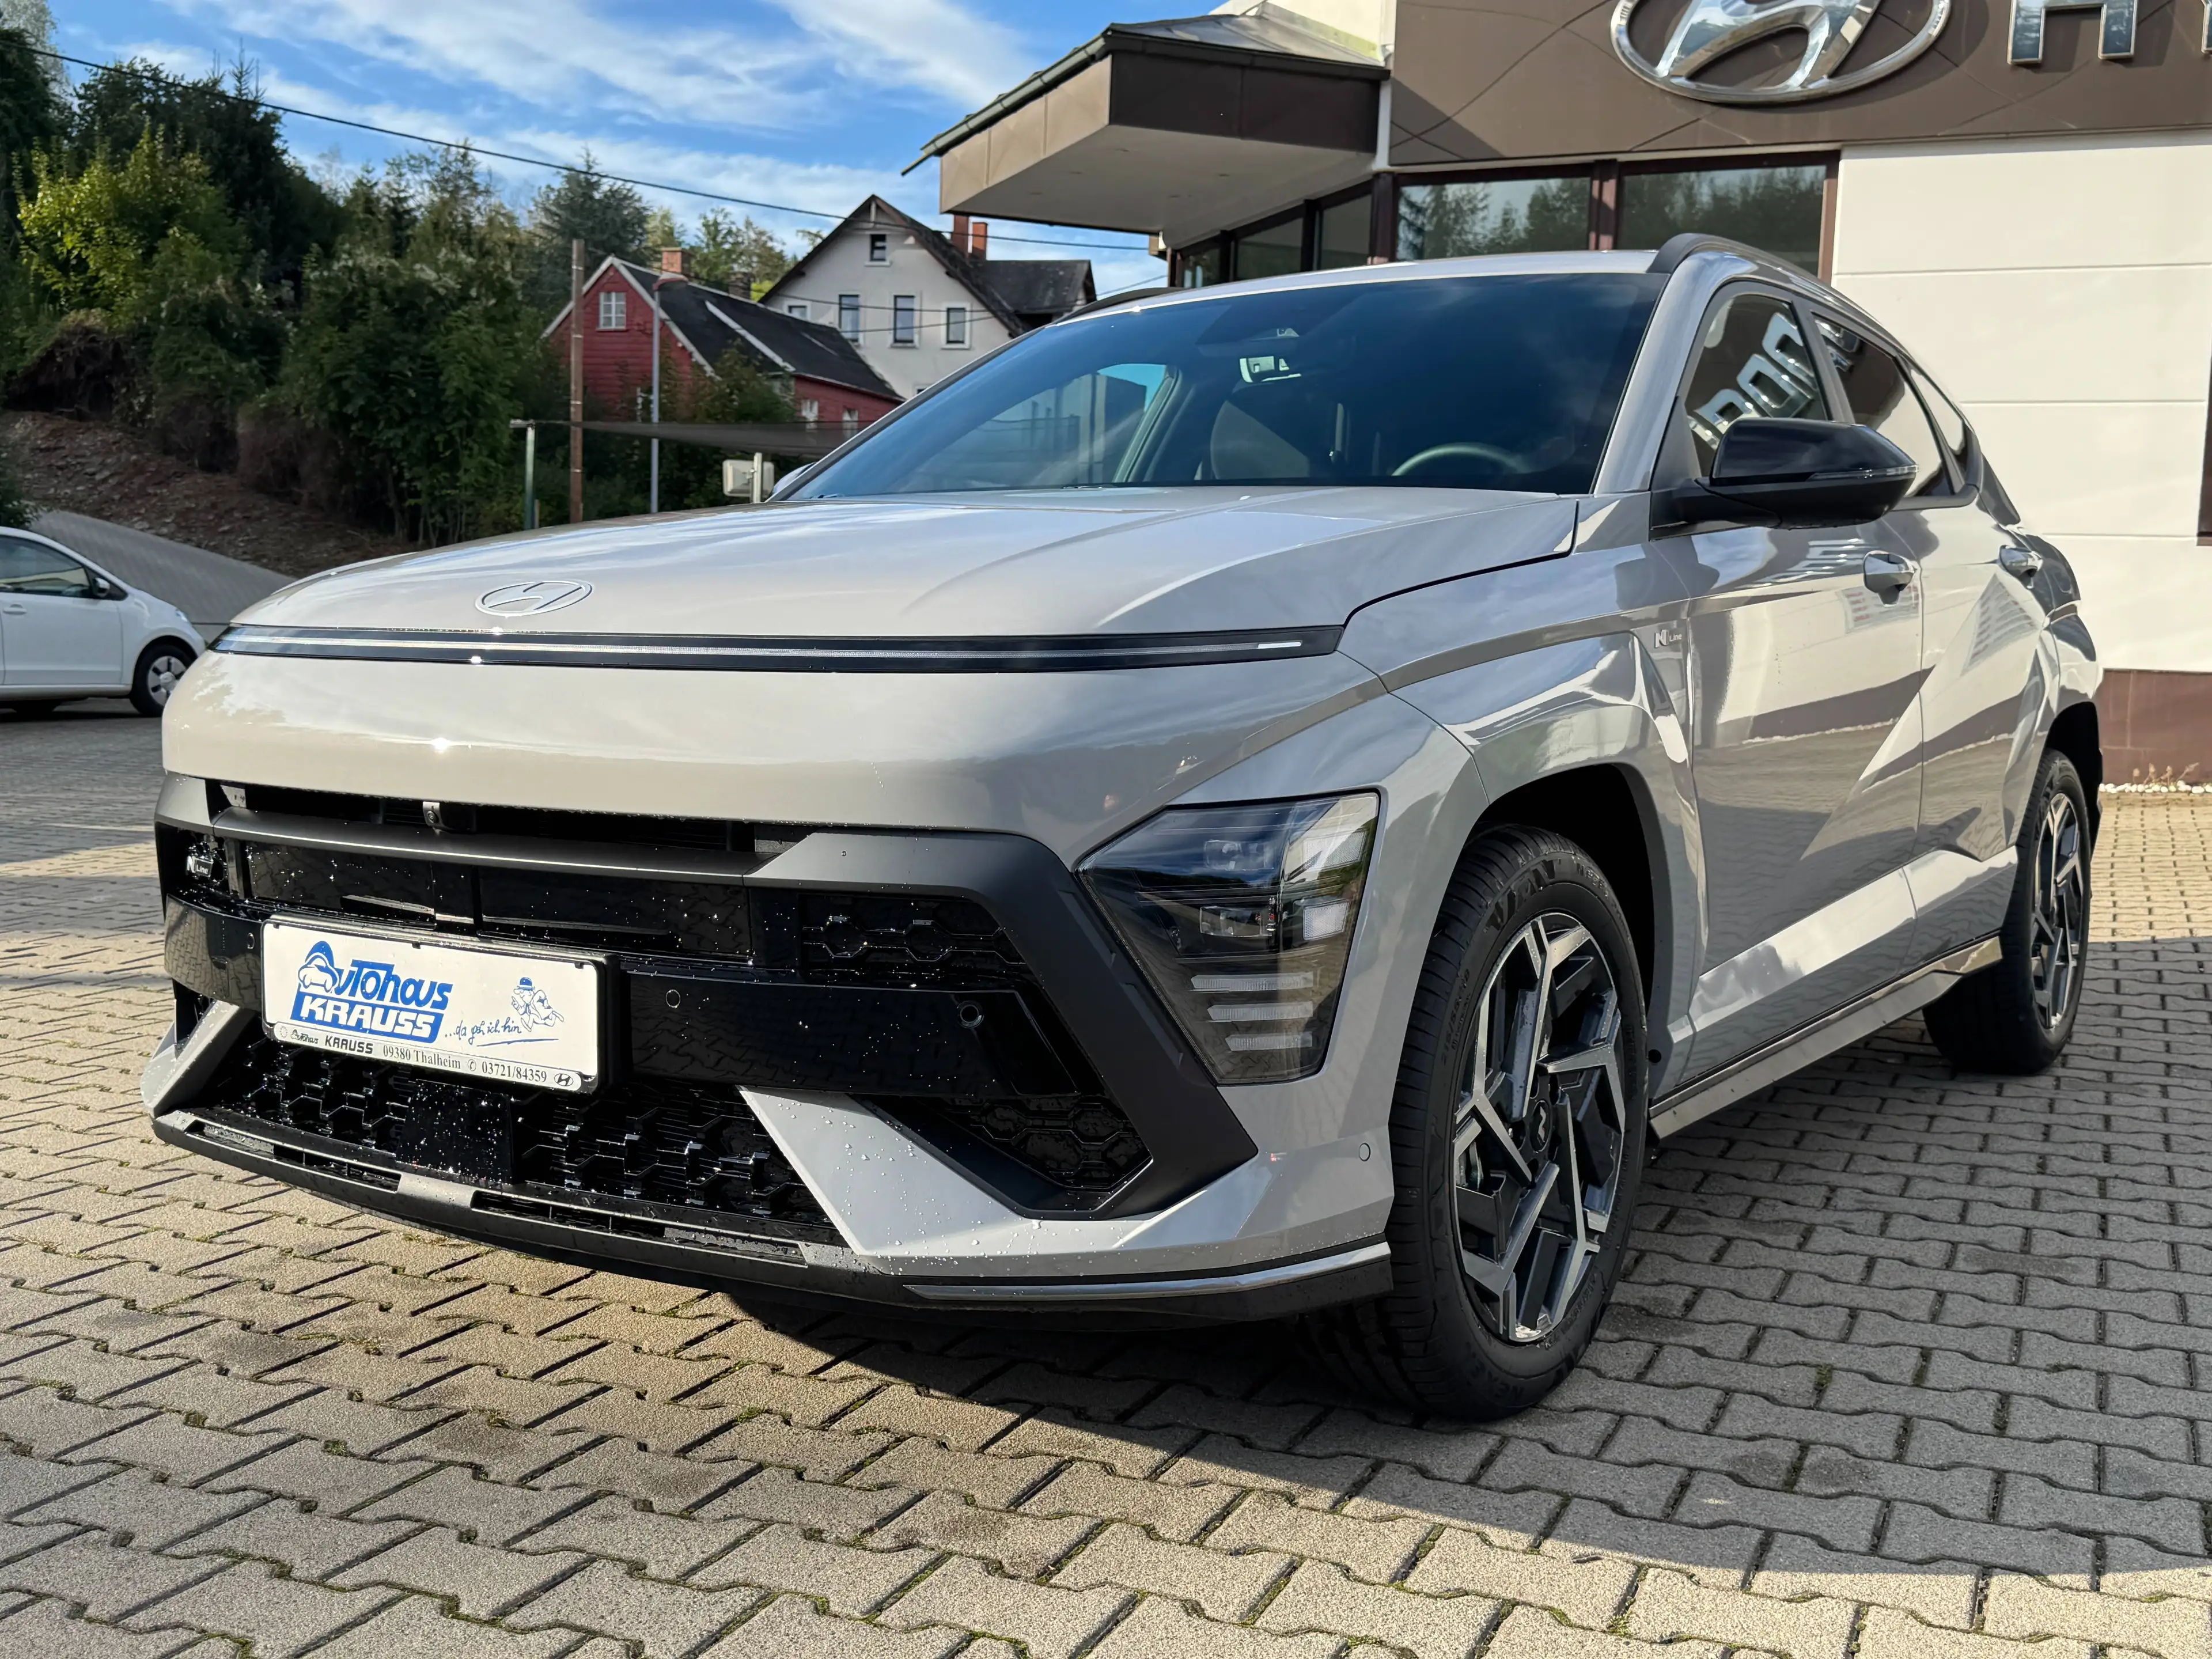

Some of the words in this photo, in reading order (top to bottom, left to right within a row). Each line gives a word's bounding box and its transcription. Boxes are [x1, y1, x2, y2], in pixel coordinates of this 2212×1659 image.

[1654, 629, 1669, 648] N
[1669, 634, 1682, 642] Line
[187, 855, 196, 873] N
[196, 864, 209, 874] Line
[300, 995, 435, 1038] KRAUSS
[487, 1019, 501, 1033] ich
[325, 1035, 374, 1054] KRAUSS
[382, 1044, 411, 1061] 09380
[413, 1050, 461, 1070] Thalheim
[482, 1063, 547, 1084] 03721/84359
